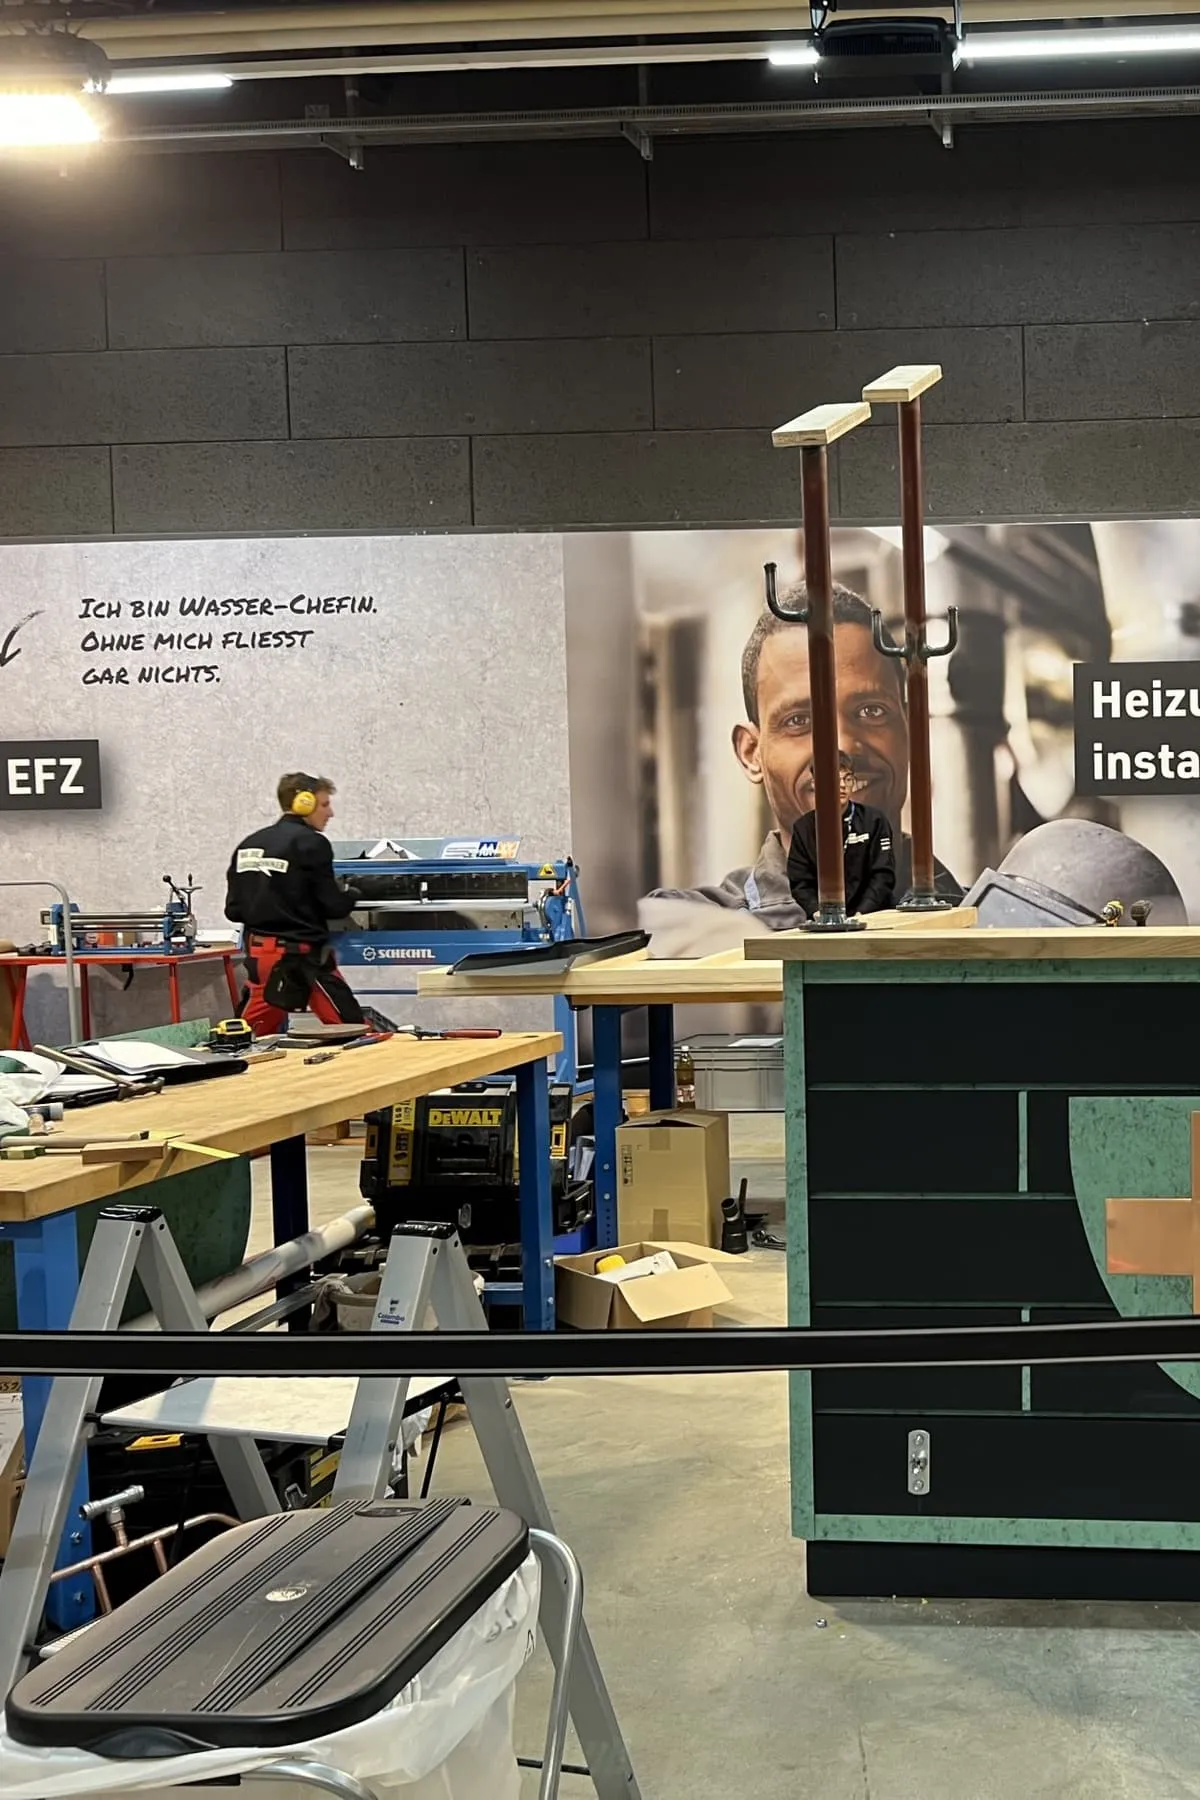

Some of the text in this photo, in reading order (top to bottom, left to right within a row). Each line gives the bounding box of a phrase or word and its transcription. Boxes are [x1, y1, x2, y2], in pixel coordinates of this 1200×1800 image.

[78, 593, 378, 619] ICH BIN WASSER-CHEFIN.
[80, 628, 314, 652] OHNE MICH FLIESST
[82, 664, 221, 685] GAR NICHTS.
[7, 757, 84, 795] EFZ
[377, 948, 436, 959] SCHECHTL
